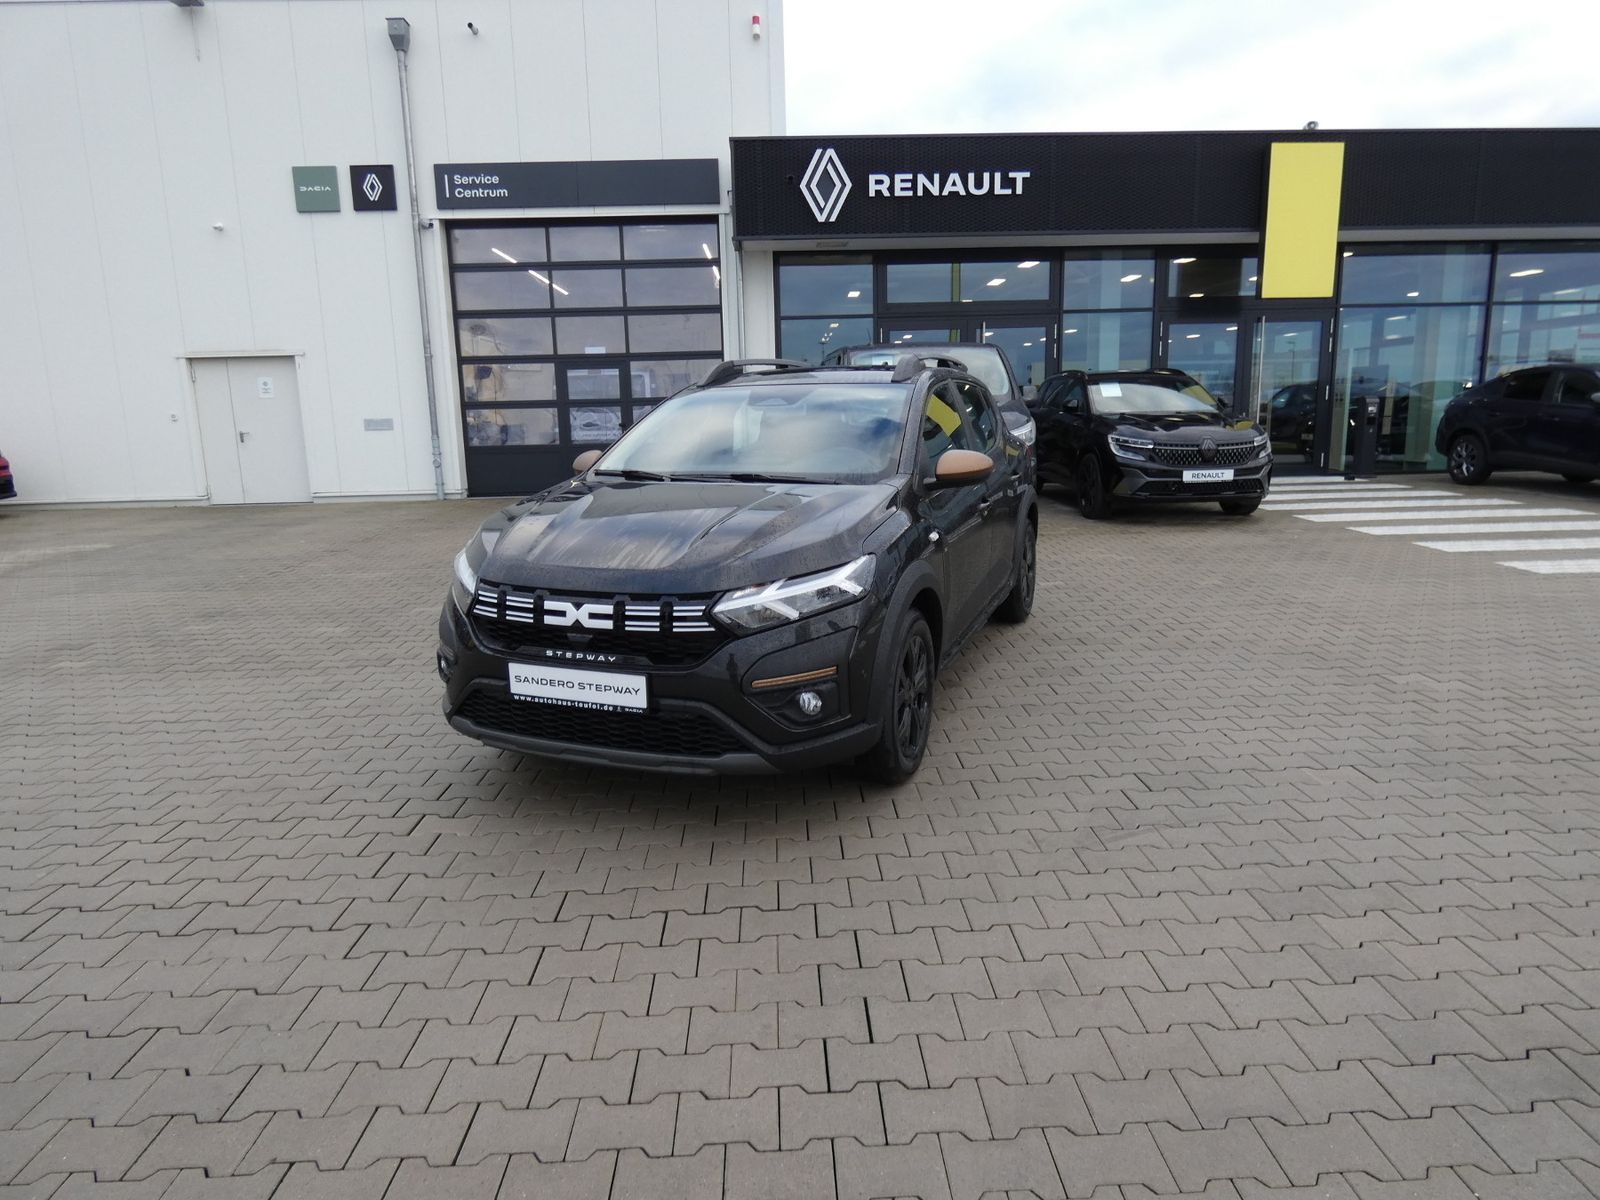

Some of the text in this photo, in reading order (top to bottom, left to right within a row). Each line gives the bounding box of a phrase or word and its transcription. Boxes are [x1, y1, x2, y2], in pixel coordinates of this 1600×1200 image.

[453, 173, 500, 185] Service
[868, 171, 1031, 197] RENAULT
[454, 187, 509, 198] Centrum
[545, 649, 616, 662] STEPWAY
[514, 675, 640, 696] SANDERO STEPWAY
[513, 694, 614, 711] www.autohaus-teufel.de
